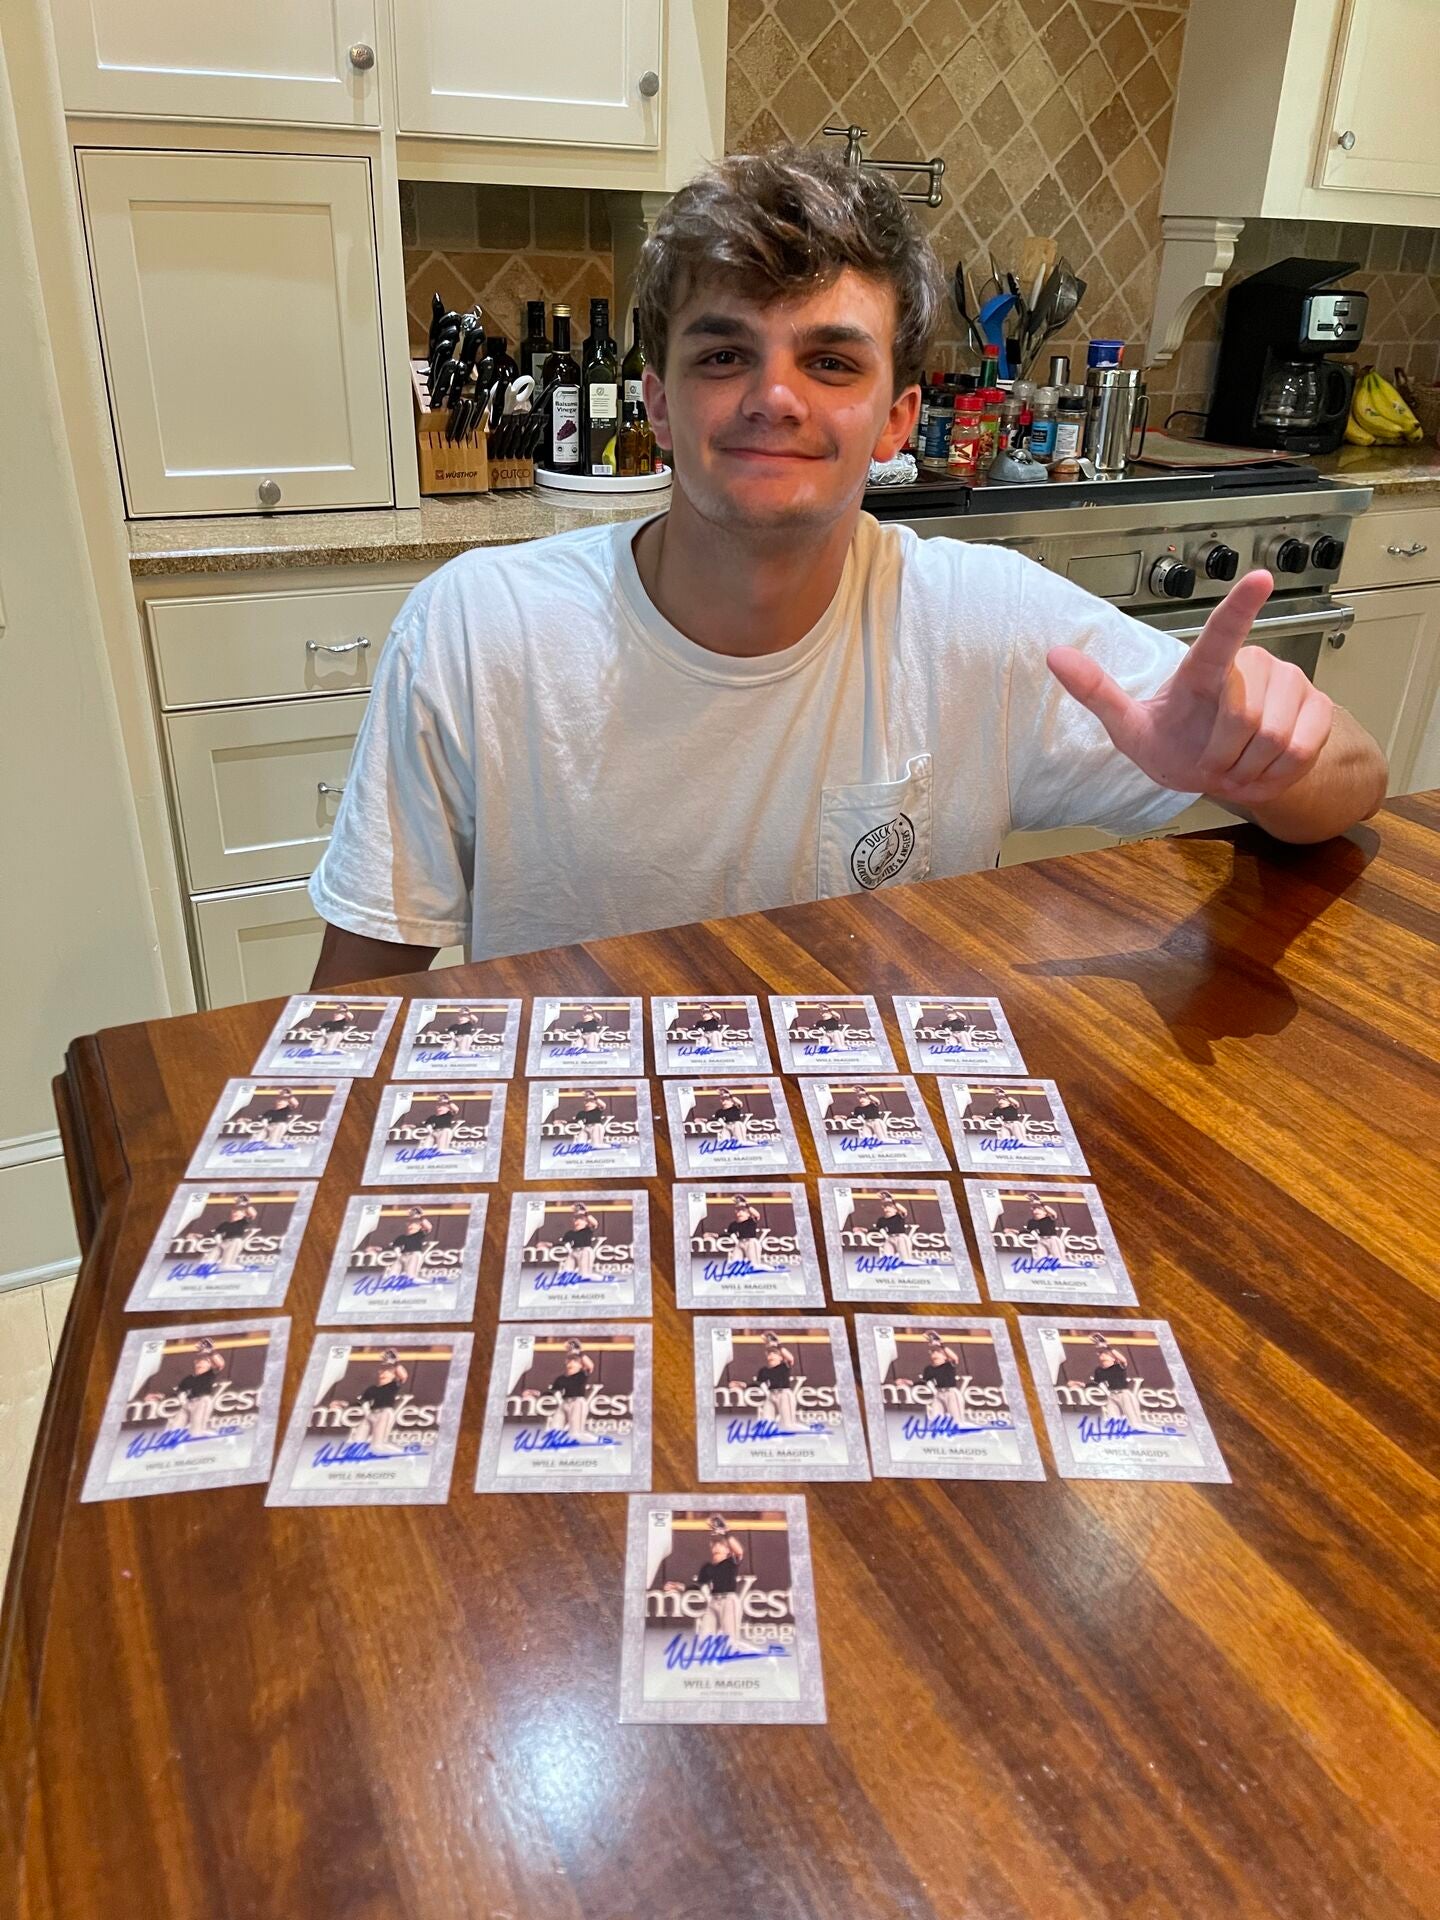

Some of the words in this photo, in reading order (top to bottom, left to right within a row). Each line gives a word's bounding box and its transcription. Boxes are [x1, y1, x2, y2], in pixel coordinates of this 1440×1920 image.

[500, 469, 530, 479] CUTCO
[865, 826, 890, 848] DUCK
[776, 1449, 814, 1457] MAGIDS
[1103, 1448, 1129, 1456] WILL
[1129, 1449, 1169, 1457] MAGIDS
[144, 1460, 172, 1470] WILL
[173, 1455, 216, 1466] MAGIDS
[354, 1472, 395, 1480] MAGIDS
[683, 1679, 712, 1689] WILL
[715, 1679, 760, 1689] MAGIDS
